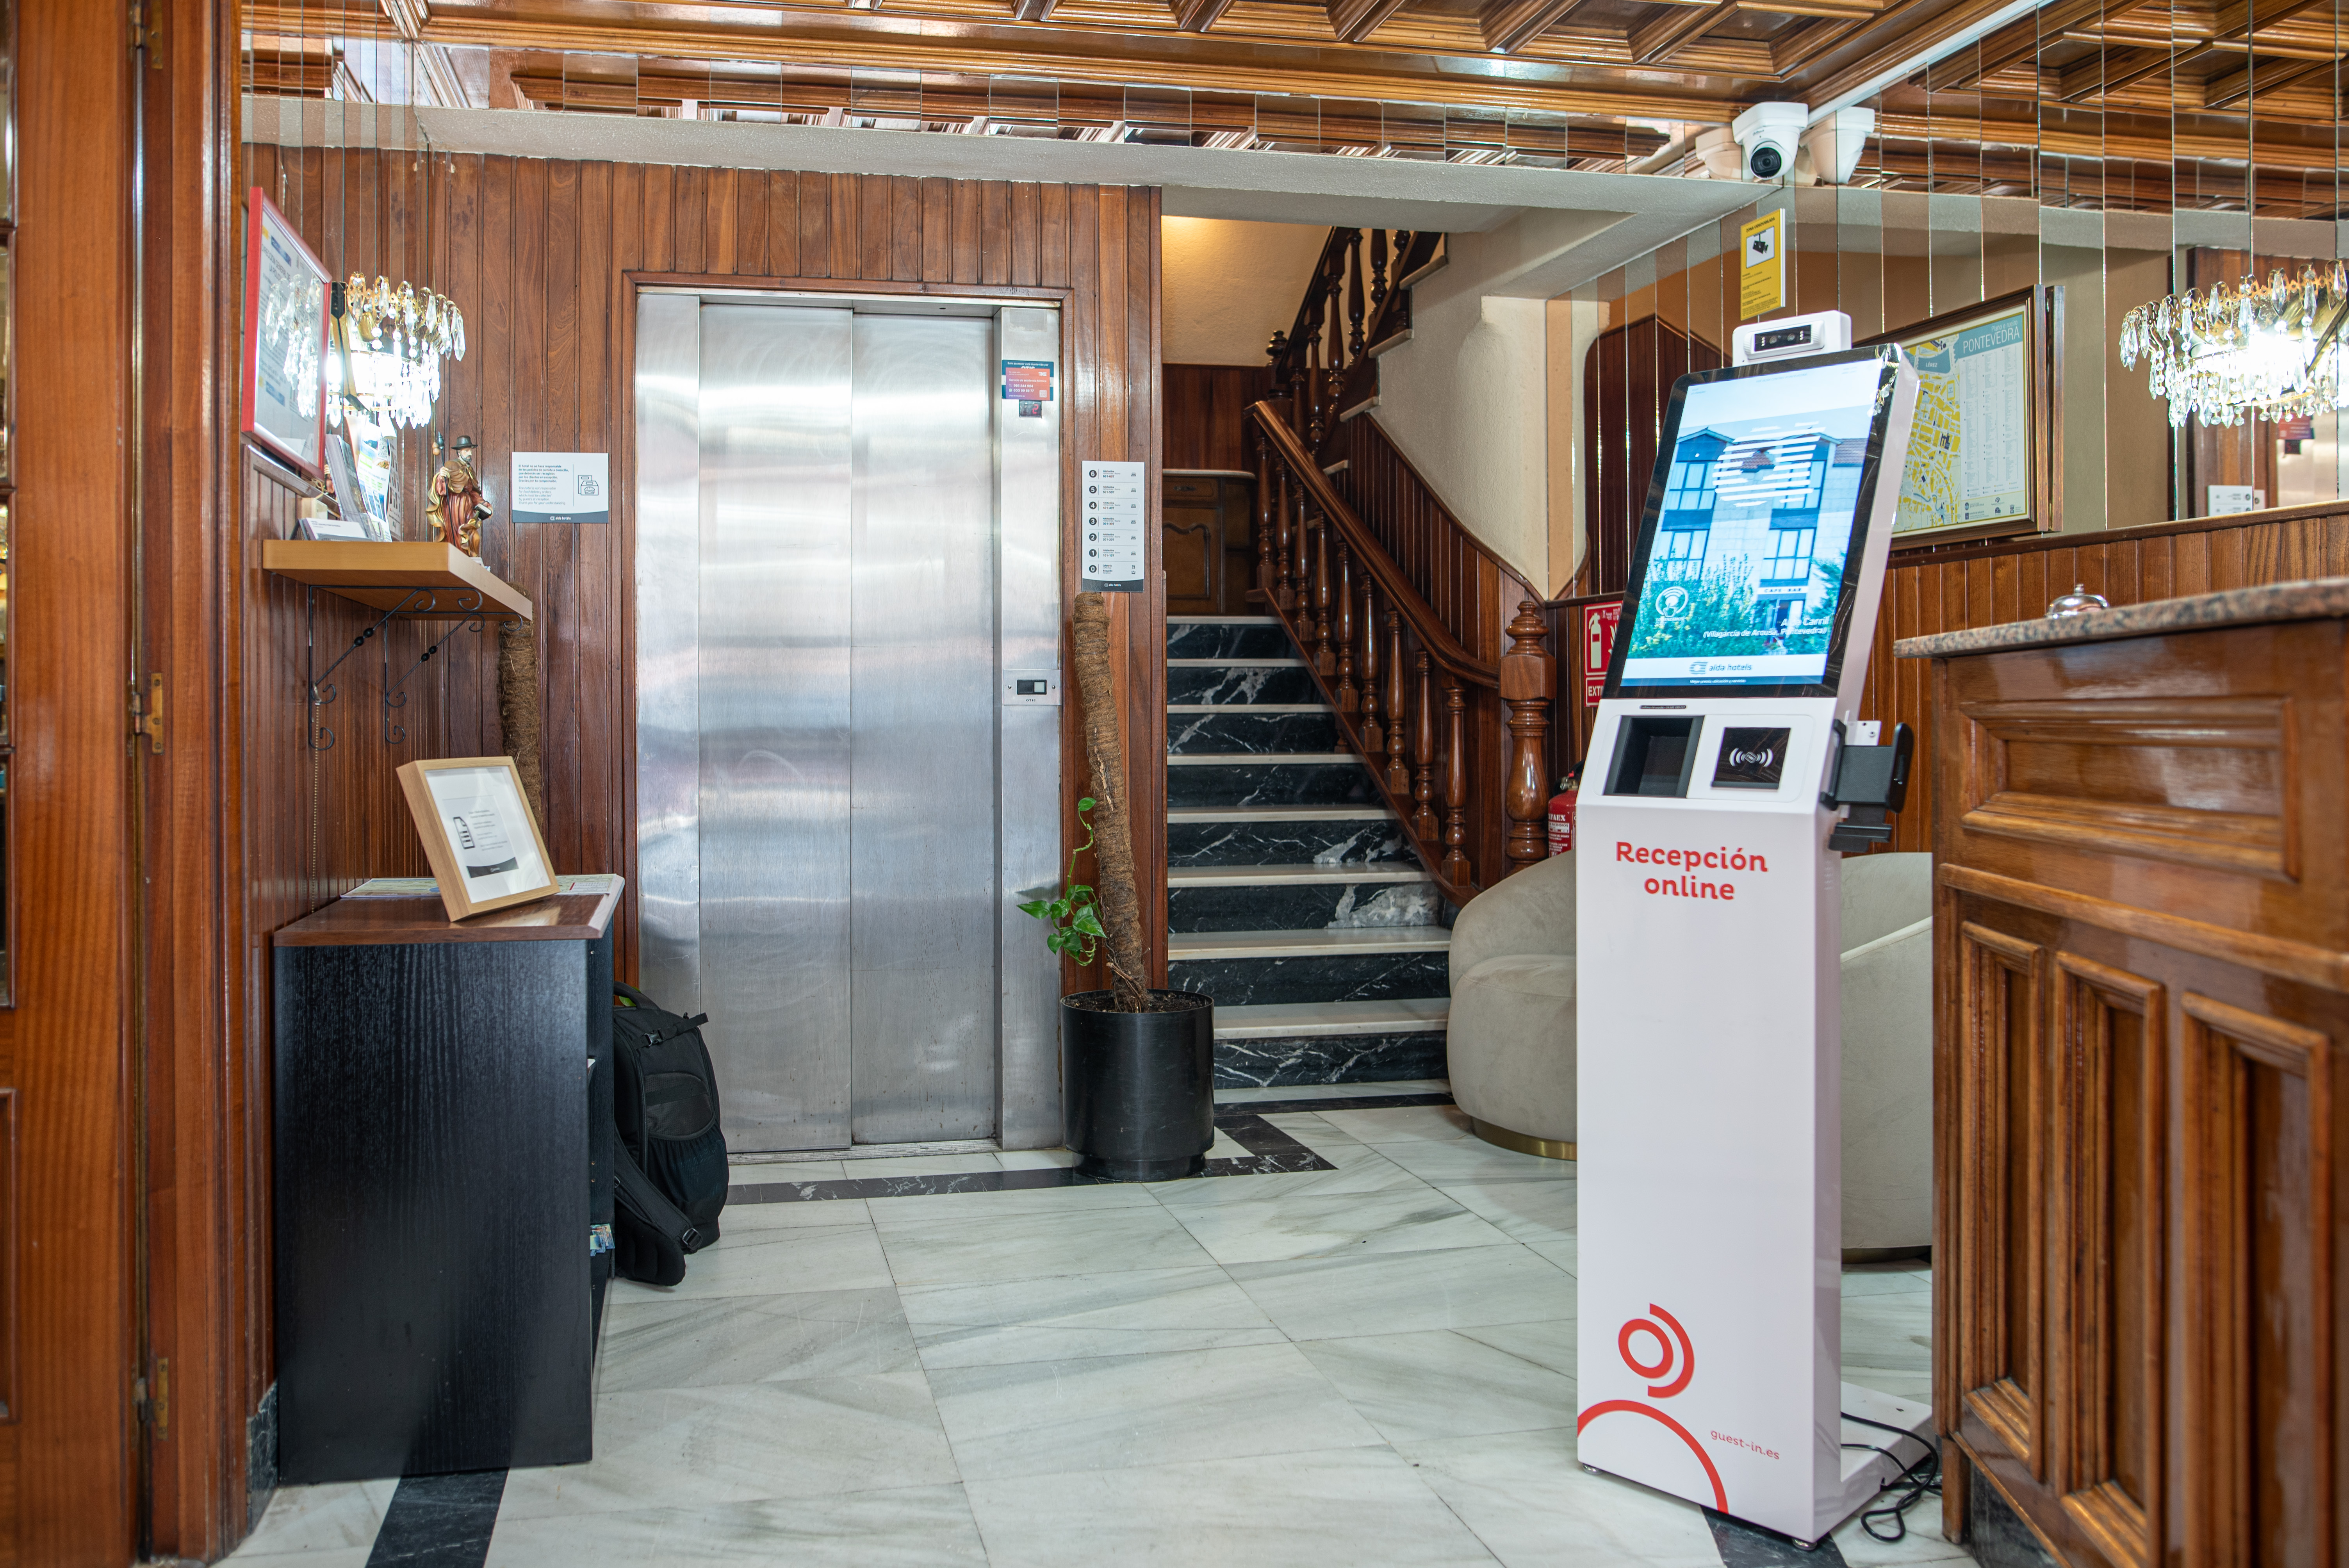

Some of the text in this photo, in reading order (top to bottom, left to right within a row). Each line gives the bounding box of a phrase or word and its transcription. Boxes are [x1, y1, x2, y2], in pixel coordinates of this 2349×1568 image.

[1963, 326, 2020, 354] PONTEVEDRA
[1032, 404, 1039, 414] 2
[1803, 615, 1830, 625] Carril
[1703, 630, 1741, 638] (Vilagarcía
[1588, 686, 1604, 697] EXTI
[1616, 841, 1768, 872] Recepción
[1644, 875, 1734, 900] online
[1711, 1430, 1780, 1460] guest-in.es
